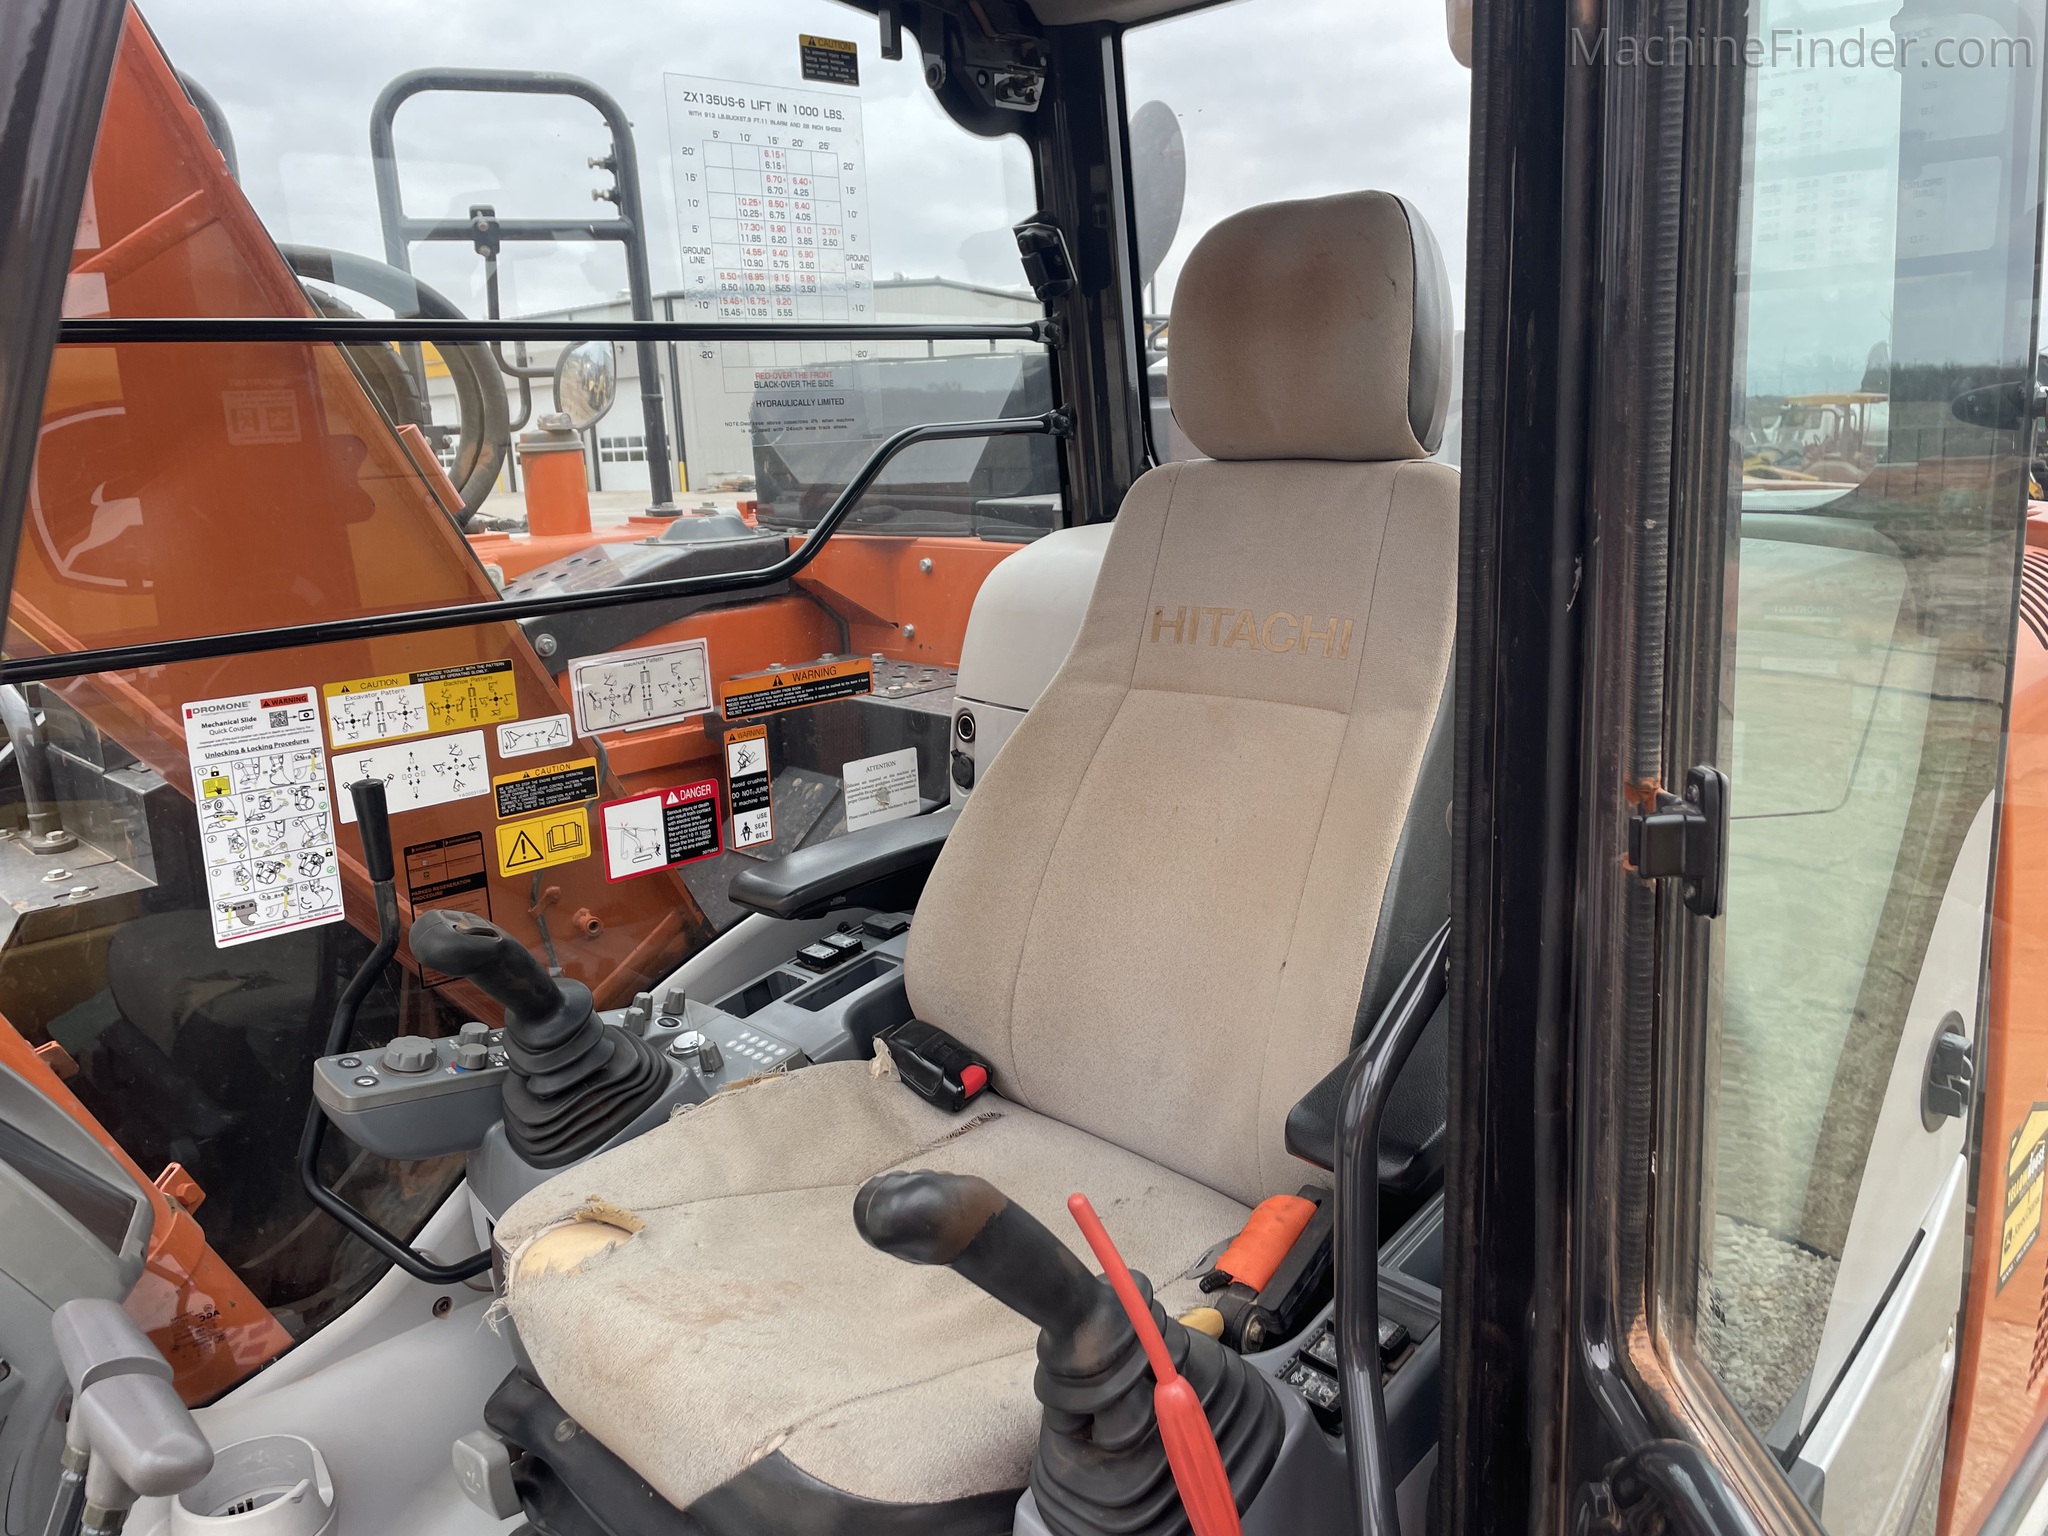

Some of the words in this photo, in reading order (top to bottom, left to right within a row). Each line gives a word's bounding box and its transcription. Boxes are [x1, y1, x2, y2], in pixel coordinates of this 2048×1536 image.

[818, 38, 852, 51] CAUTION
[683, 91, 745, 109] ZX135US-6
[751, 99, 771, 111] LIFT
[777, 102, 787, 113] IN
[793, 105, 819, 117] 1000
[824, 108, 845, 120] LBS.
[712, 130, 720, 139] 5'
[740, 133, 751, 142] 10'
[768, 136, 779, 145] 15'
[792, 138, 803, 147] 20'
[818, 141, 830, 150] 25'
[682, 146, 695, 156] 20'
[843, 162, 854, 171] 20'
[685, 173, 698, 182] 15'
[845, 186, 856, 195] 15'
[687, 198, 699, 208] 10'
[847, 210, 858, 219] 10'
[692, 224, 700, 233] 5'
[682, 246, 711, 255] GROUND
[689, 255, 705, 264] LINE
[845, 254, 870, 262] GROUND
[851, 263, 865, 271] LINE
[755, 372, 792, 380] RED-OVER
[794, 371, 808, 379] THE
[810, 371, 833, 379] FRONT
[754, 380, 800, 389] BLACK-OVER
[802, 379, 816, 388] THE
[818, 379, 834, 387] SIDE
[755, 399, 816, 408] HYDRAULICALLY
[817, 398, 845, 406] LIMITED
[1150, 605, 1354, 660] HITACHI
[416, 670, 442, 678] FAMILIARIZE
[792, 665, 837, 682] WARNING
[360, 678, 398, 690] CAUTION
[443, 679, 468, 687] Backhoe
[471, 675, 493, 683] Pattern
[345, 693, 378, 701] Excavator
[380, 688, 406, 696] Pattern
[271, 695, 307, 705] WARNING
[192, 702, 249, 714] DROMONE
[201, 718, 239, 728] Mechanical
[228, 724, 253, 732] Coupler
[737, 728, 764, 739] WARNING
[204, 749, 239, 759] Unlocking
[247, 743, 273, 752] Locking
[273, 738, 310, 748] Procedures
[534, 763, 571, 776] CAUTION
[865, 760, 897, 773] ATTENTION
[732, 780, 745, 789] Avoid
[747, 776, 767, 785] crushing
[680, 784, 712, 801] DANGER
[731, 791, 740, 799] DO
[741, 789, 753, 797] NOT
[755, 786, 769, 795] JUMP
[738, 797, 758, 806] machine
[756, 812, 768, 820] USE
[754, 821, 769, 830] SEAT
[755, 830, 769, 839] BELT
[411, 888, 432, 896] PARKED
